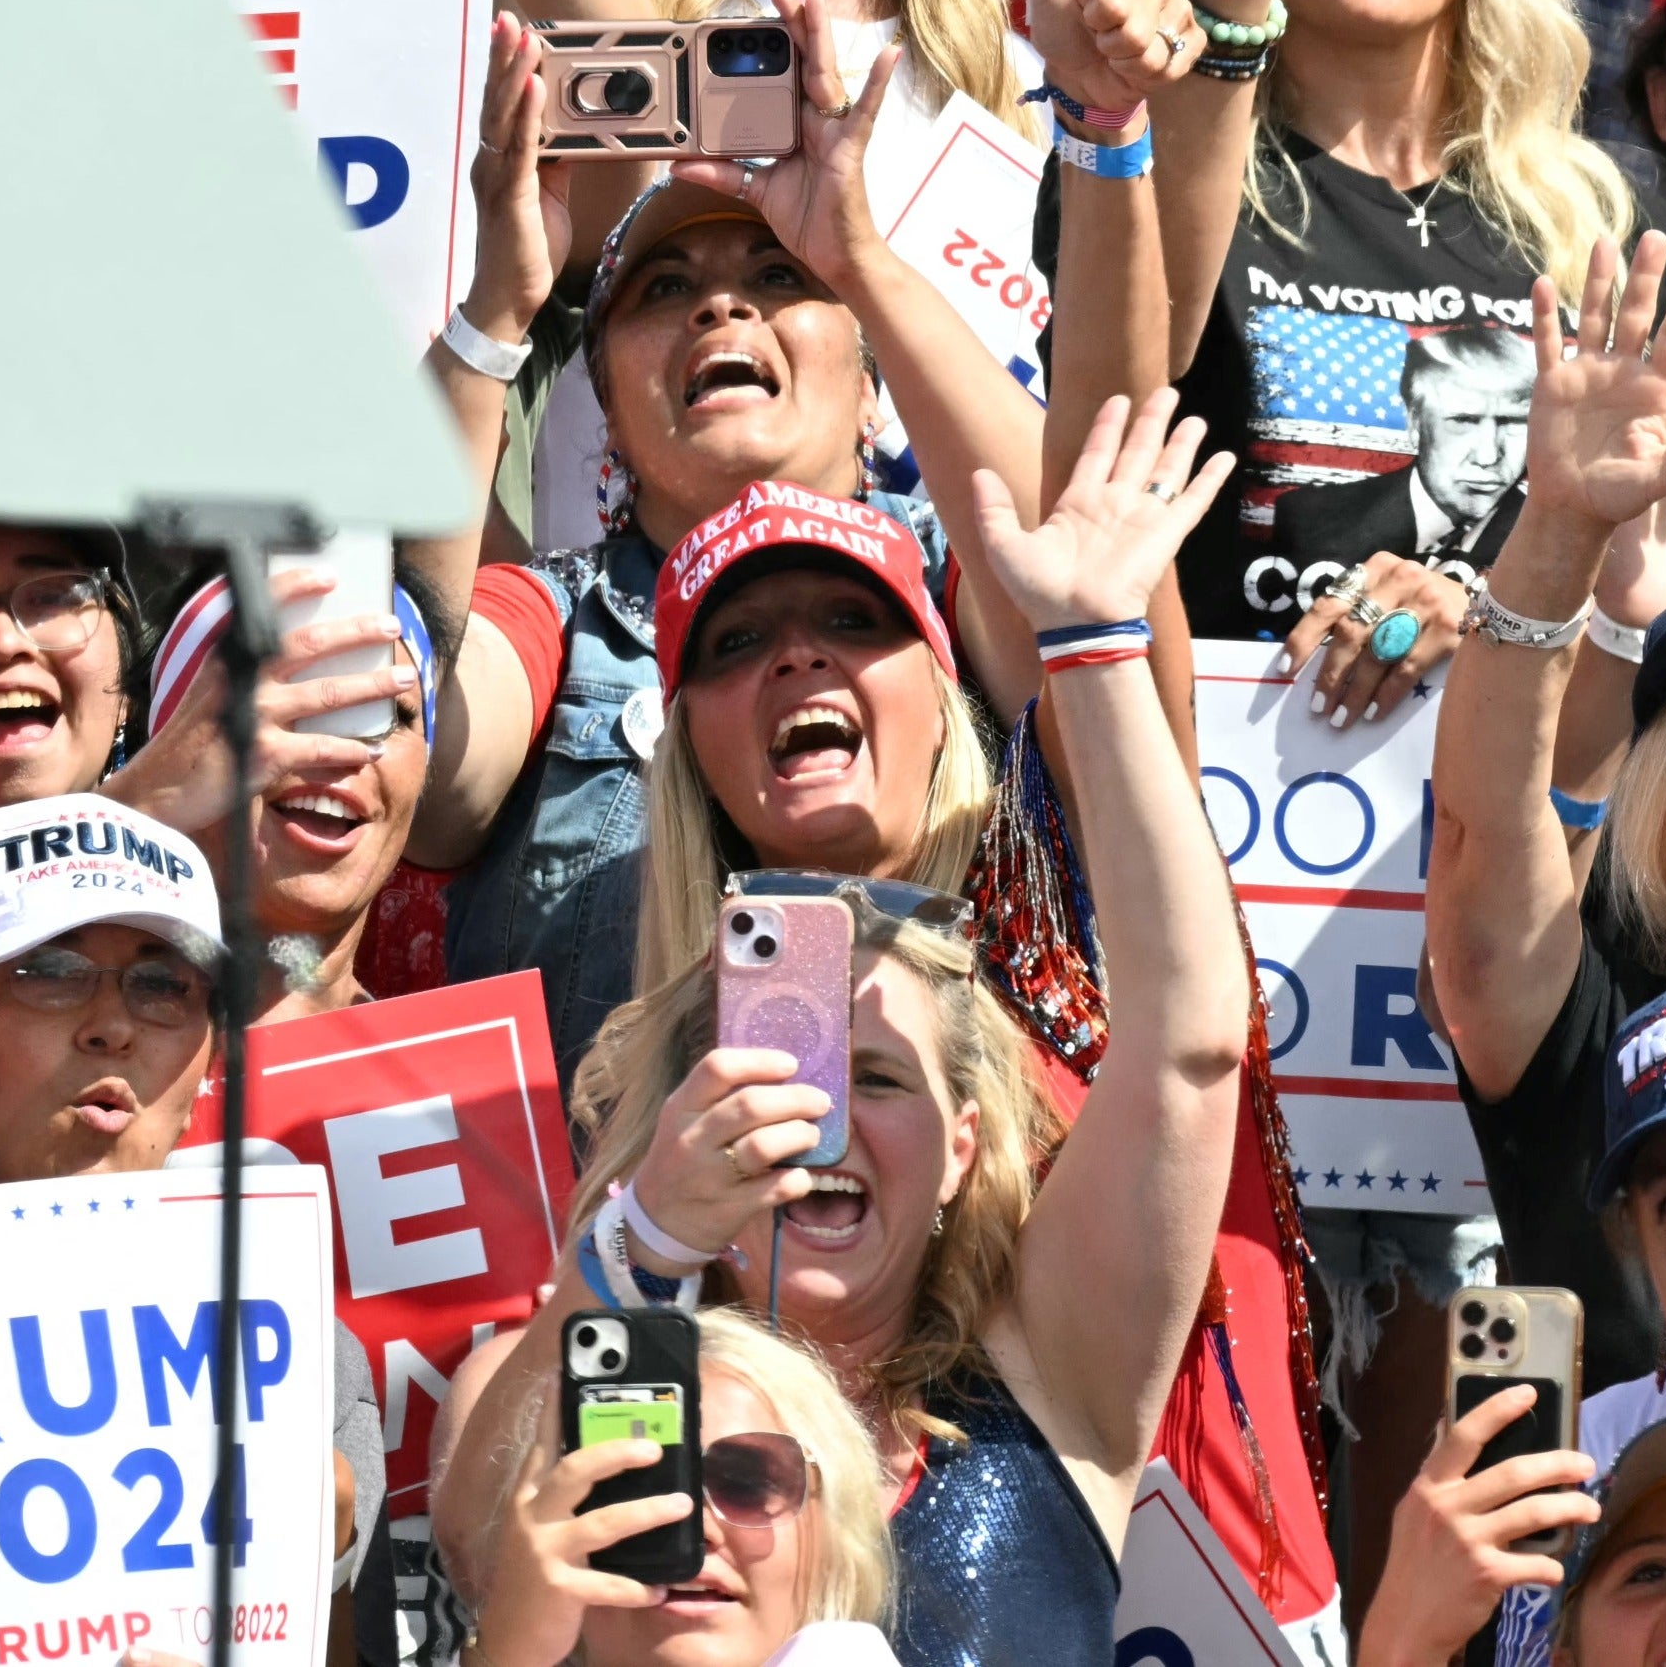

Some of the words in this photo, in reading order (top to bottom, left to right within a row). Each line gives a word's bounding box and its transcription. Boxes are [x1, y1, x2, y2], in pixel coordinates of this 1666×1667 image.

[1247, 265, 1303, 307] I'M
[1309, 284, 1466, 326] VOTING
[671, 499, 743, 584] MAKE
[742, 479, 902, 541] AMERICA
[679, 517, 771, 602] GREAT
[781, 516, 886, 565] AGAIN
[1483, 600, 1523, 632] TRUMP
[15, 863, 62, 885] TAKE
[71, 872, 145, 896] 2024
